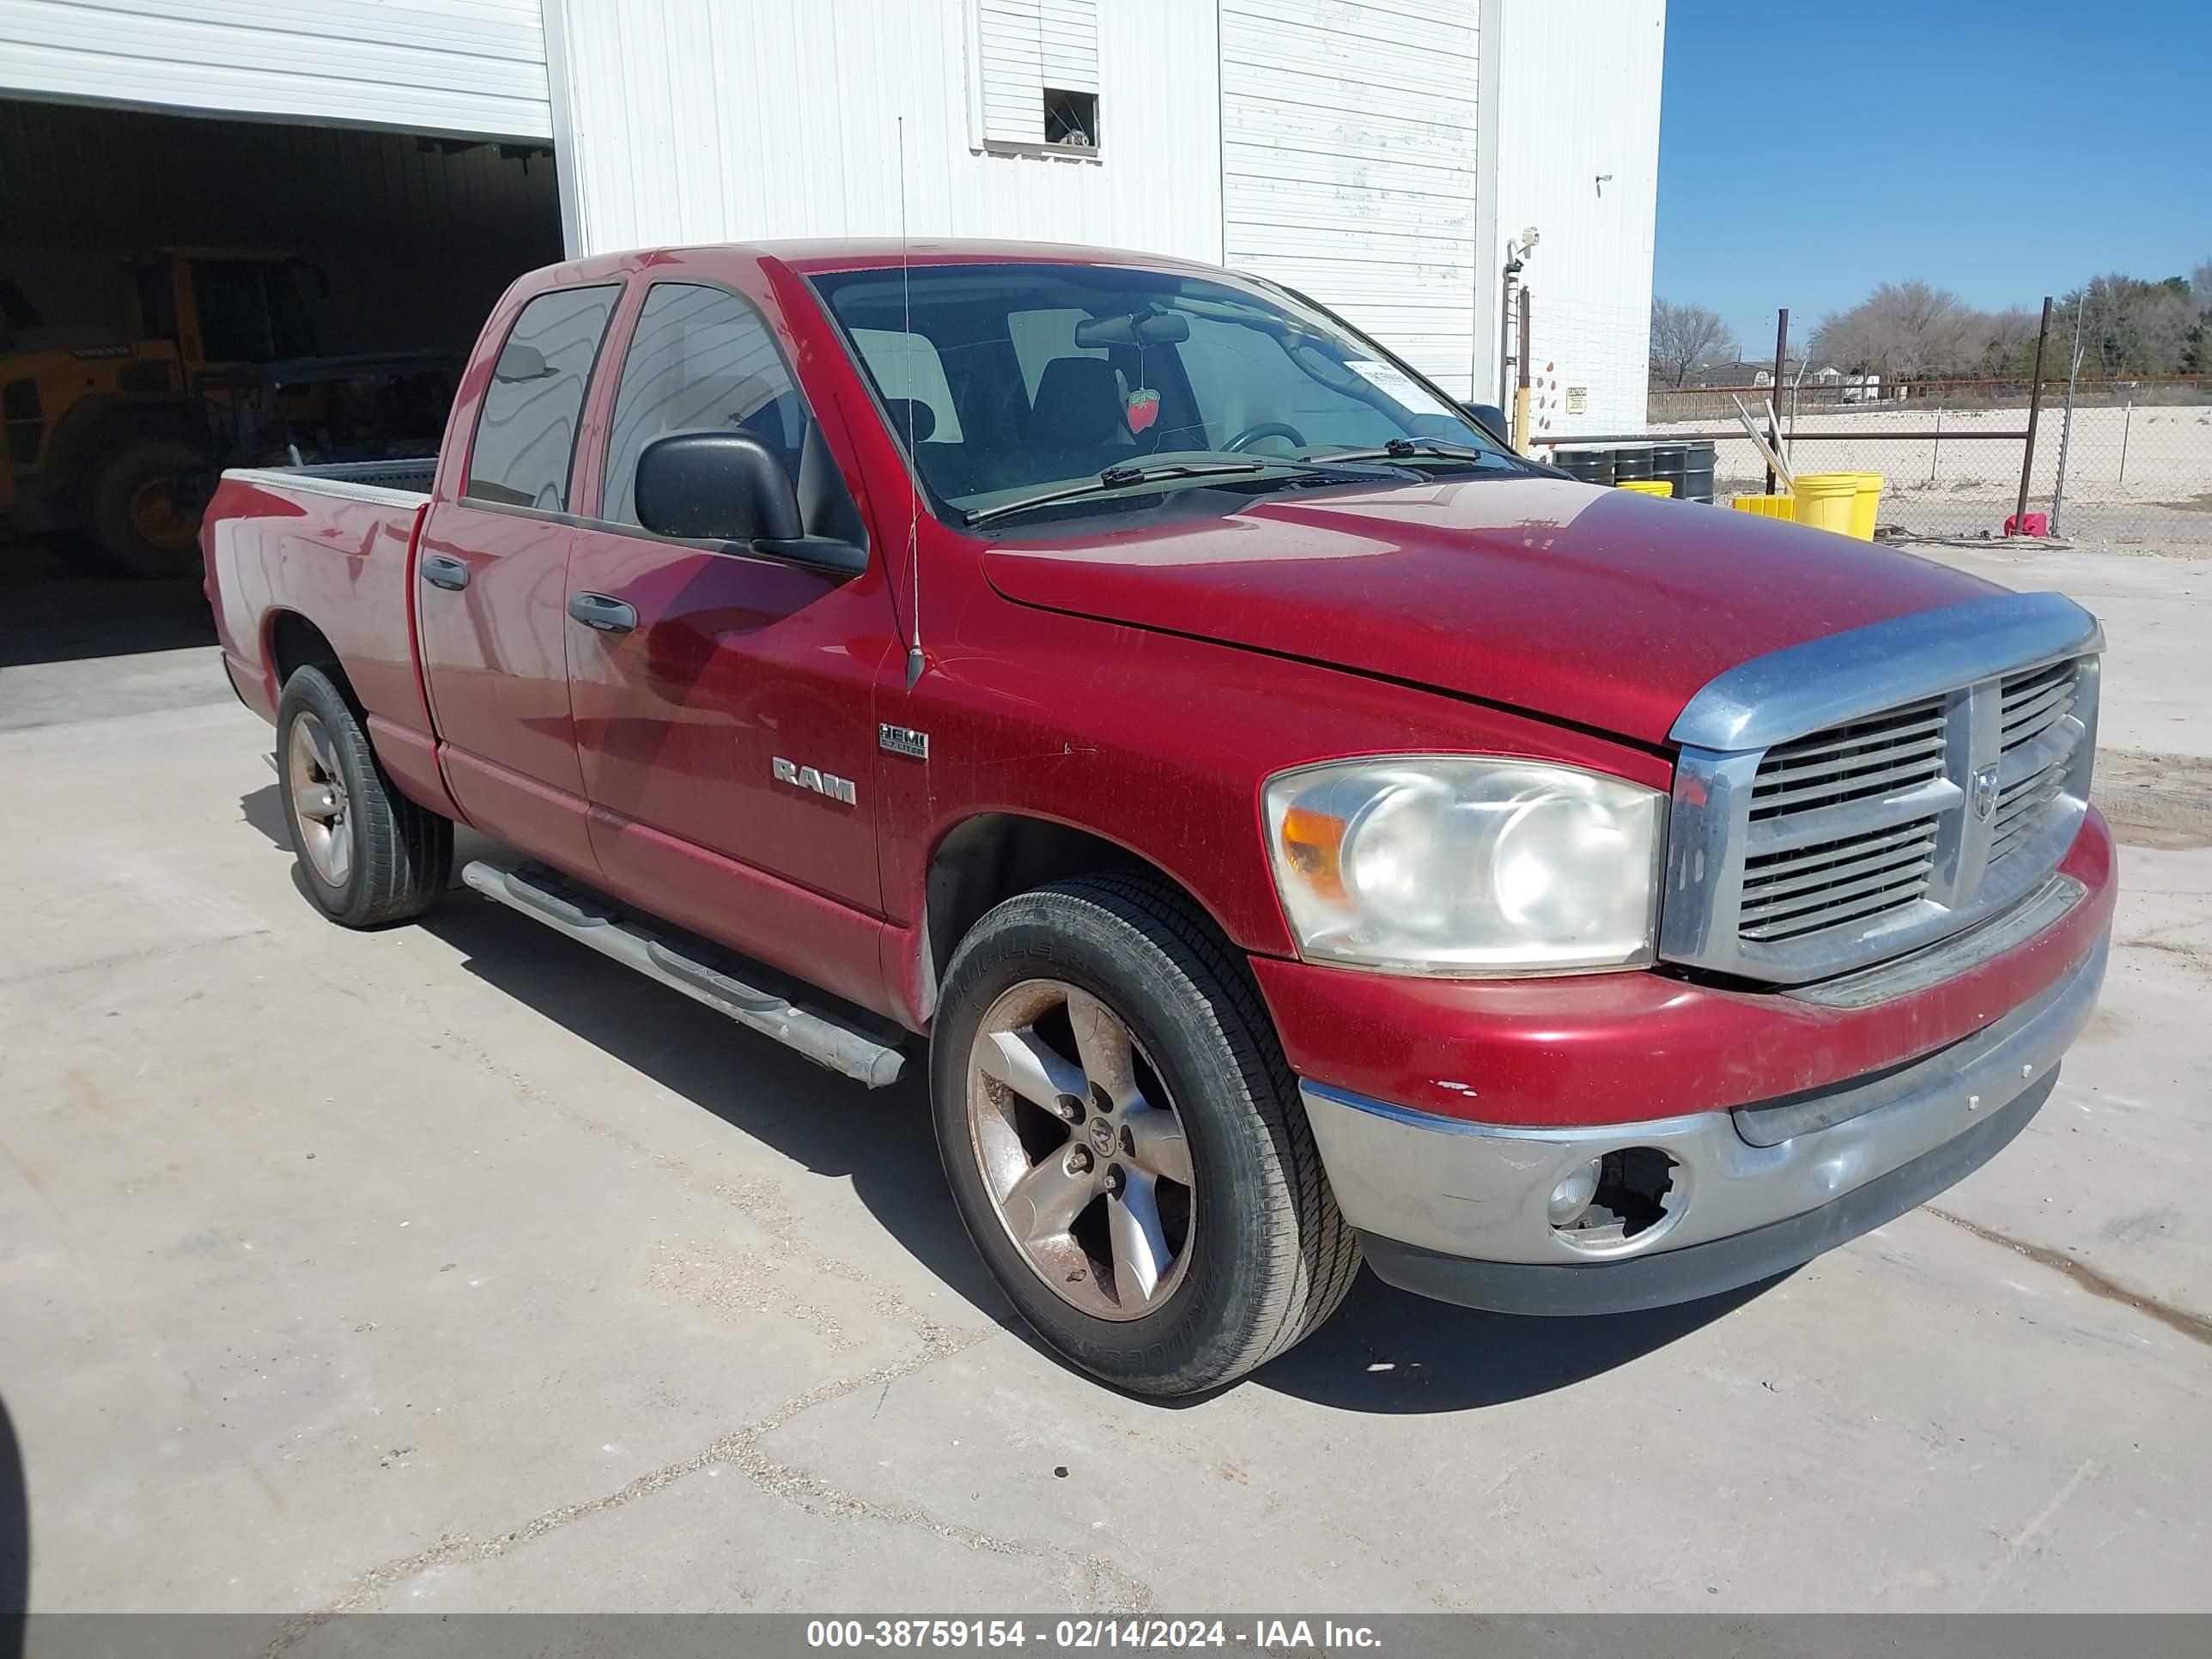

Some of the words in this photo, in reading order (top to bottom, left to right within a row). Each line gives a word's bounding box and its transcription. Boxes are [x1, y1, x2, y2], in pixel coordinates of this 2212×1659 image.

[879, 725, 925, 748] HEMI
[897, 742, 926, 756] LITER
[772, 756, 857, 805] RAM
